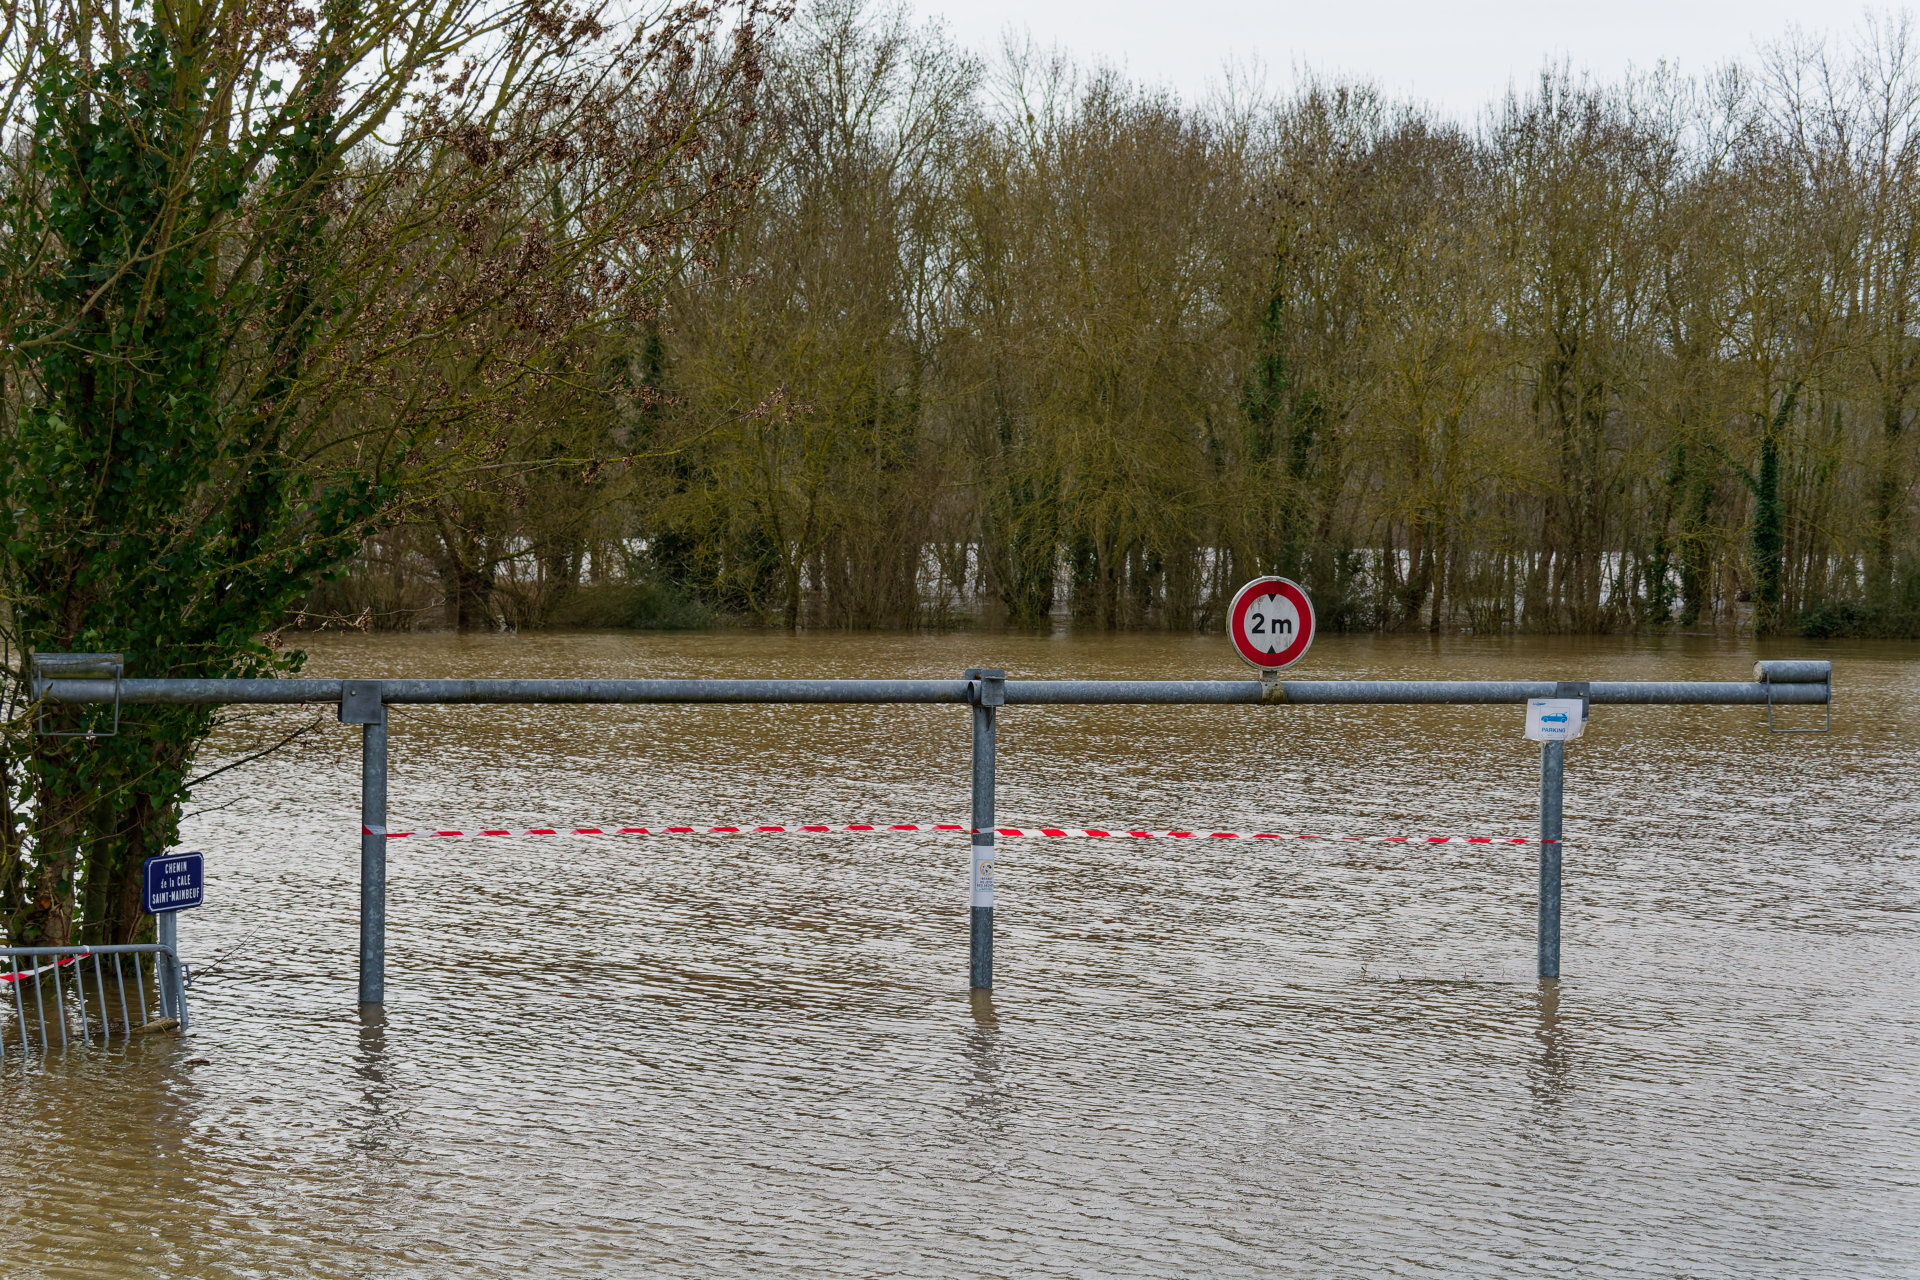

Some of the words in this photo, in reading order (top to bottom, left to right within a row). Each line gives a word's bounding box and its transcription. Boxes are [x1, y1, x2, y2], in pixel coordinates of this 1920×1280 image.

[1252, 613, 1265, 634] 2
[1271, 618, 1292, 634] m
[165, 861, 187, 874] CHEMIN
[161, 878, 167, 889] de
[169, 877, 175, 888] la
[177, 874, 191, 887] CALE
